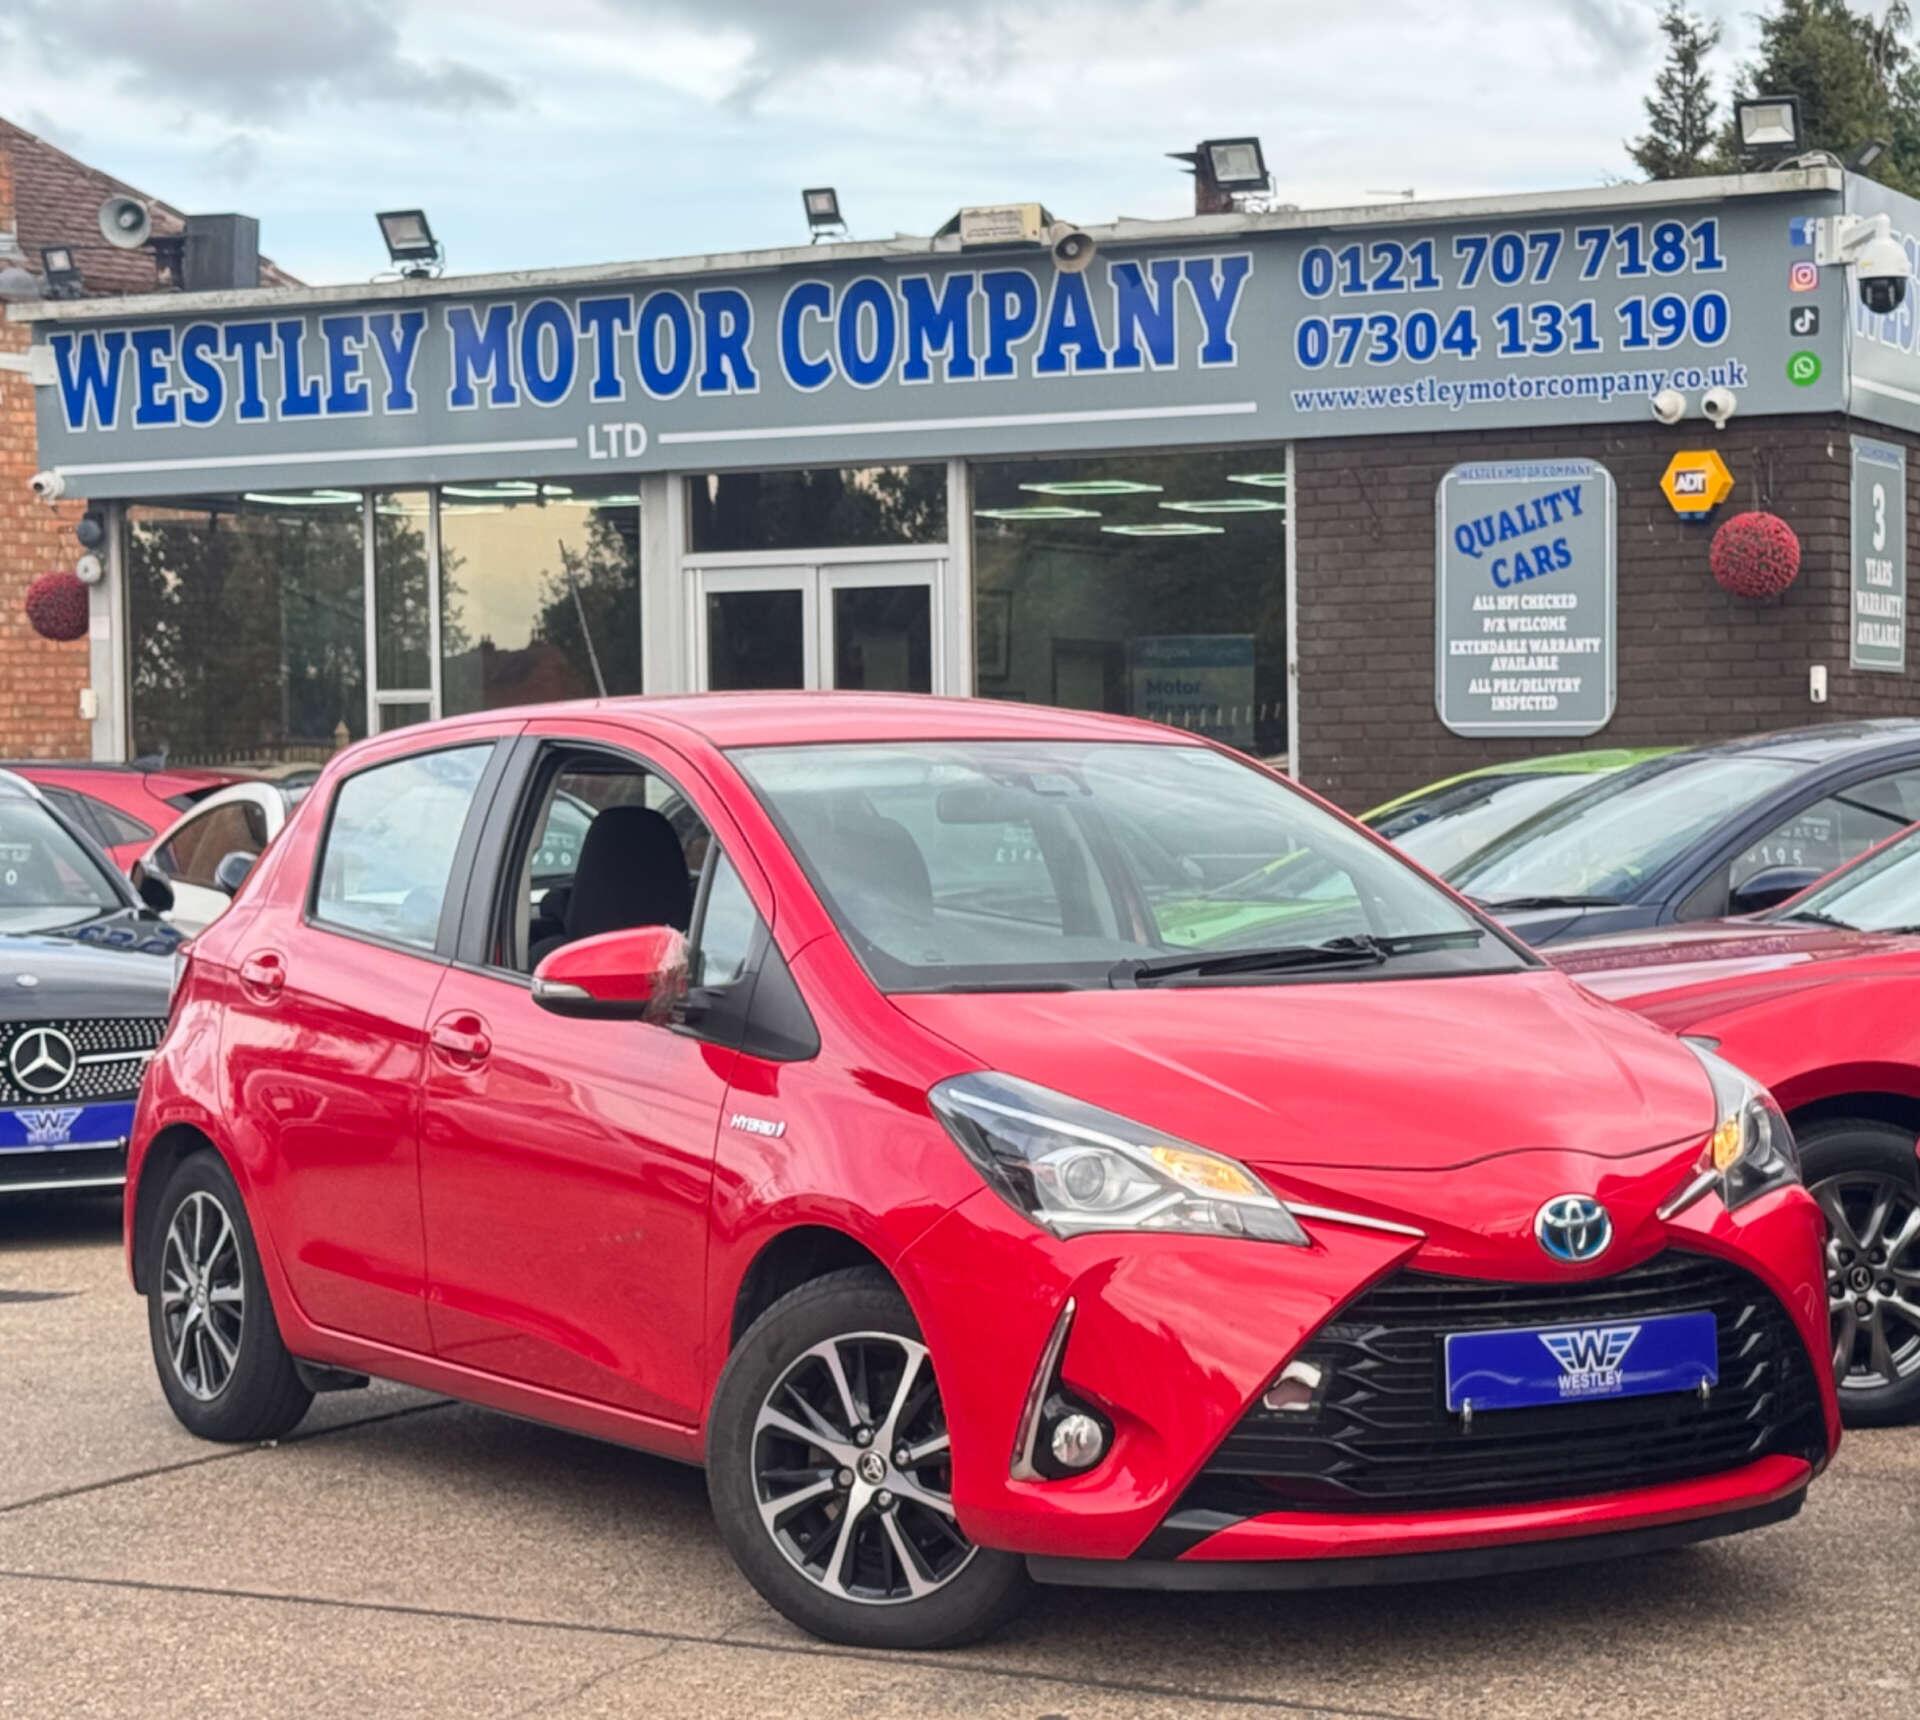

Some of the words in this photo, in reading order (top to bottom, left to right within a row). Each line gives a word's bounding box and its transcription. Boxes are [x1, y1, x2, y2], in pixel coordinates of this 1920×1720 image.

[1299, 239, 1441, 299] 0121
[1454, 229, 1565, 288] 707
[1576, 217, 1725, 280] 7181
[47, 308, 428, 433] WESTLEY
[445, 286, 760, 411] MOTOR
[777, 251, 1254, 393] COMPANY
[1294, 305, 1479, 371] 07304
[1494, 299, 1603, 359] 131
[1618, 291, 1731, 351] 190
[1292, 357, 1747, 412] www.westleymotorcompany.co.uk
[587, 422, 648, 460] LTD
[1674, 471, 1708, 492] ADT
[1453, 484, 1583, 559] QUALITY
[1871, 482, 1887, 552] 3
[1490, 537, 1573, 589] CARS
[1472, 594, 1496, 611] ALL
[1520, 592, 1578, 610] CHECKED
[1507, 615, 1568, 633] WELCOME
[1449, 638, 1528, 656] EXTENDABLE
[1528, 637, 1602, 654] WARRANTY
[1490, 655, 1560, 672] AVAILABLE
[1468, 678, 1492, 694] ALL
[1492, 676, 1582, 694] PRE/DELIVERY
[1491, 695, 1559, 712] INSPECTED
[1557, 1369, 1624, 1390] WESTLEY
